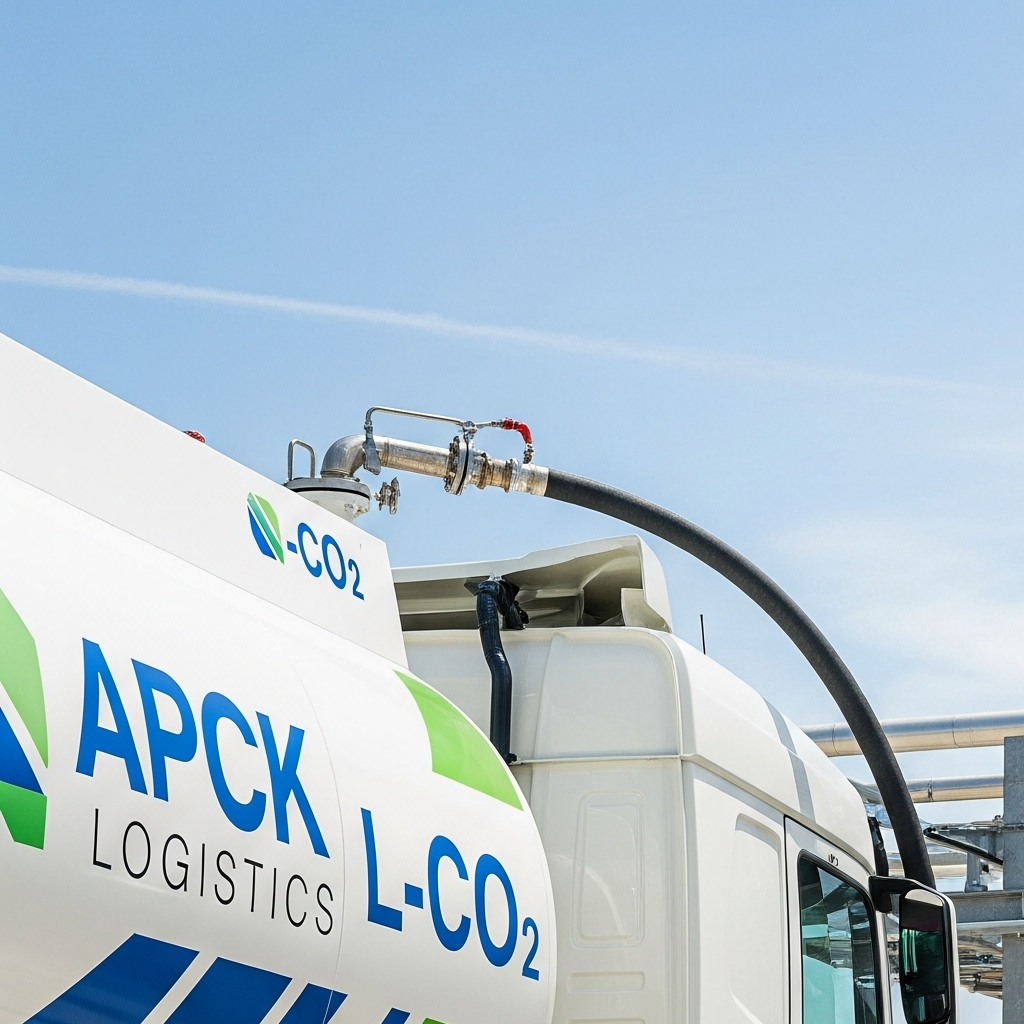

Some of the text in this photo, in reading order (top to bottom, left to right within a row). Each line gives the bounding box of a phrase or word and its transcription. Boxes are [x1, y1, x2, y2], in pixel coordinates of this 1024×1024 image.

[75, 637, 330, 859] APCK
[92, 808, 334, 936] LOGISTICS
[360, 807, 540, 981] L-CO2
